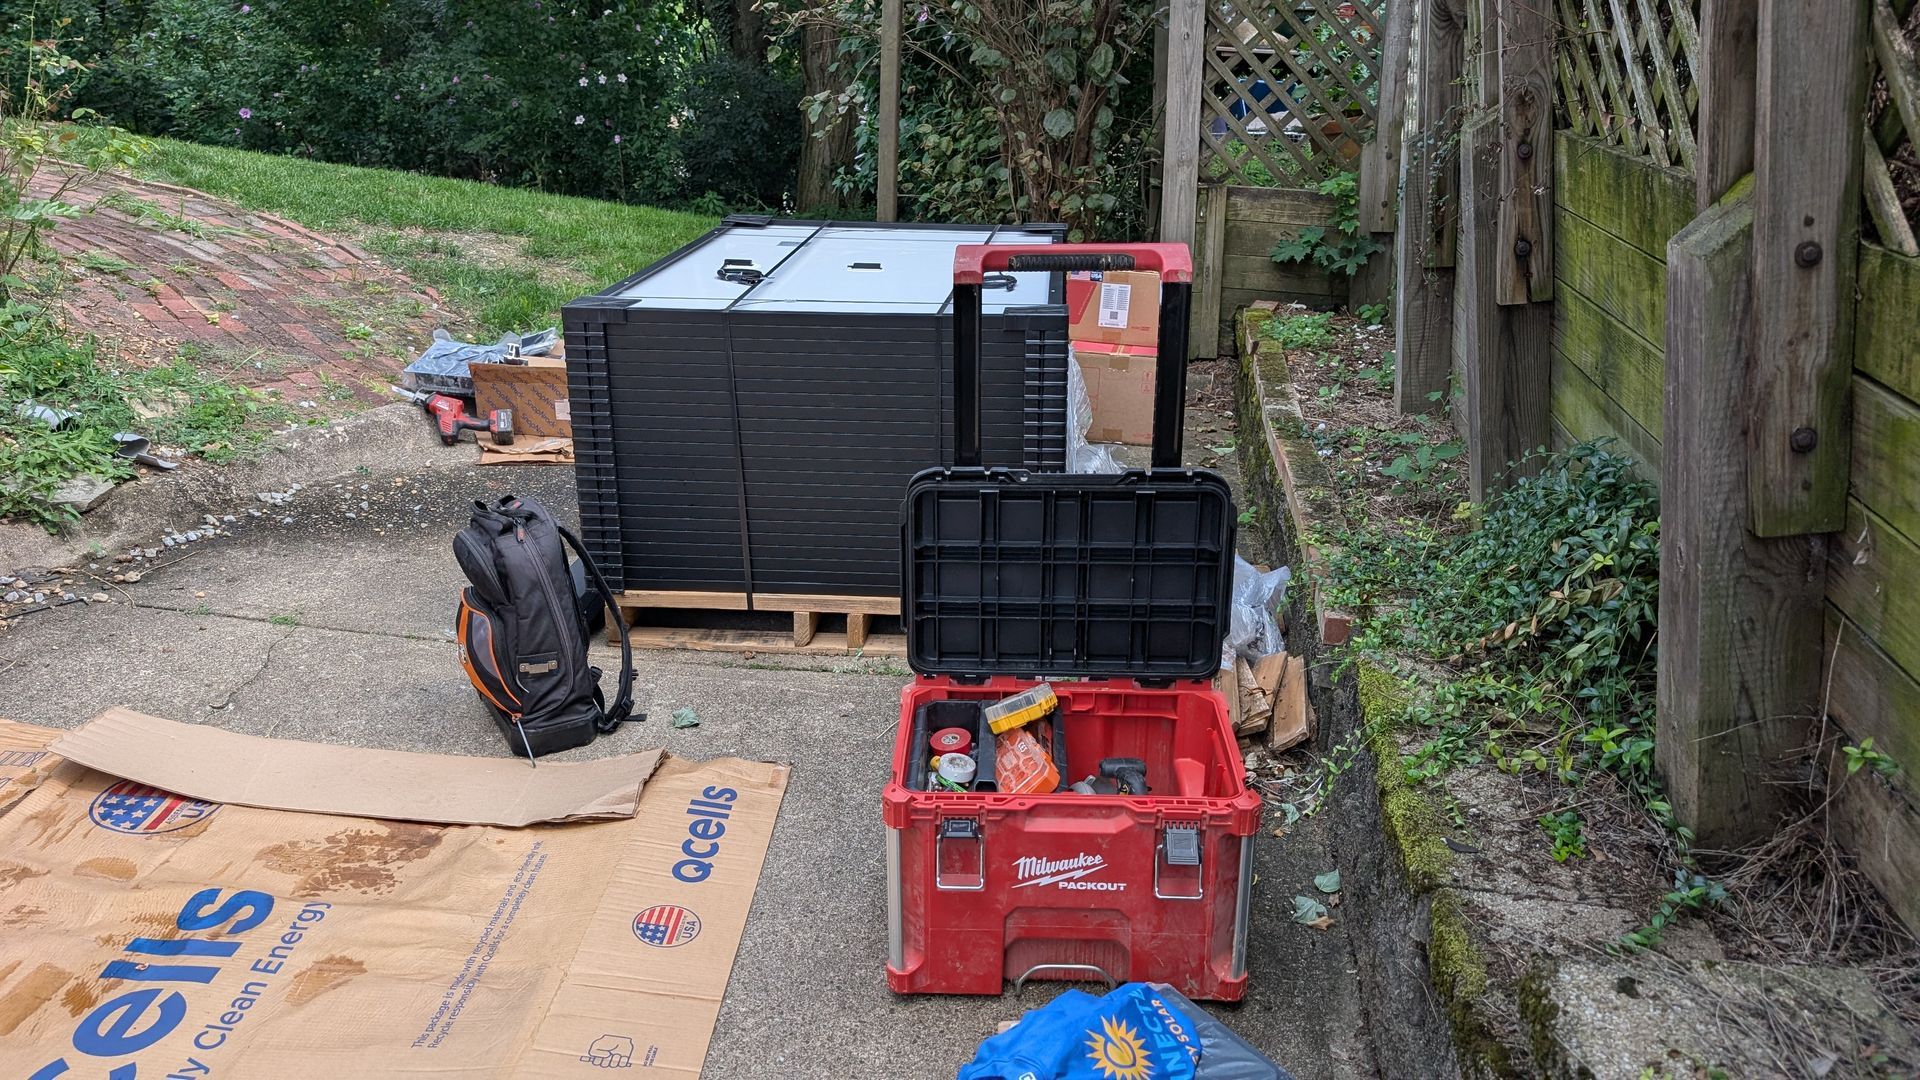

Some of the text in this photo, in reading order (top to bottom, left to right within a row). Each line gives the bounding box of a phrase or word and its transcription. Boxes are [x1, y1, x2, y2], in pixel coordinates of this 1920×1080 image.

[672, 786, 737, 883] Qcells
[1011, 852, 1104, 880] Milwaukee
[1058, 881, 1127, 891] PACKOUT
[427, 1021, 453, 1048] Recycle
[450, 978, 480, 1020] responsibly
[475, 960, 488, 977] with
[482, 939, 500, 961] Qcells
[504, 889, 530, 924] completely
[523, 873, 536, 889] clean
[681, 920, 697, 939] USA
[194, 979, 268, 1050] Clean
[250, 901, 331, 974] Energy
[411, 1034, 429, 1048] This
[426, 999, 450, 1033] package
[448, 971, 467, 990] made
[463, 956, 476, 972] with
[473, 927, 493, 953] recycled
[489, 897, 510, 928] materials
[505, 884, 517, 898] and
[1151, 999, 1189, 1043] SOLAR
